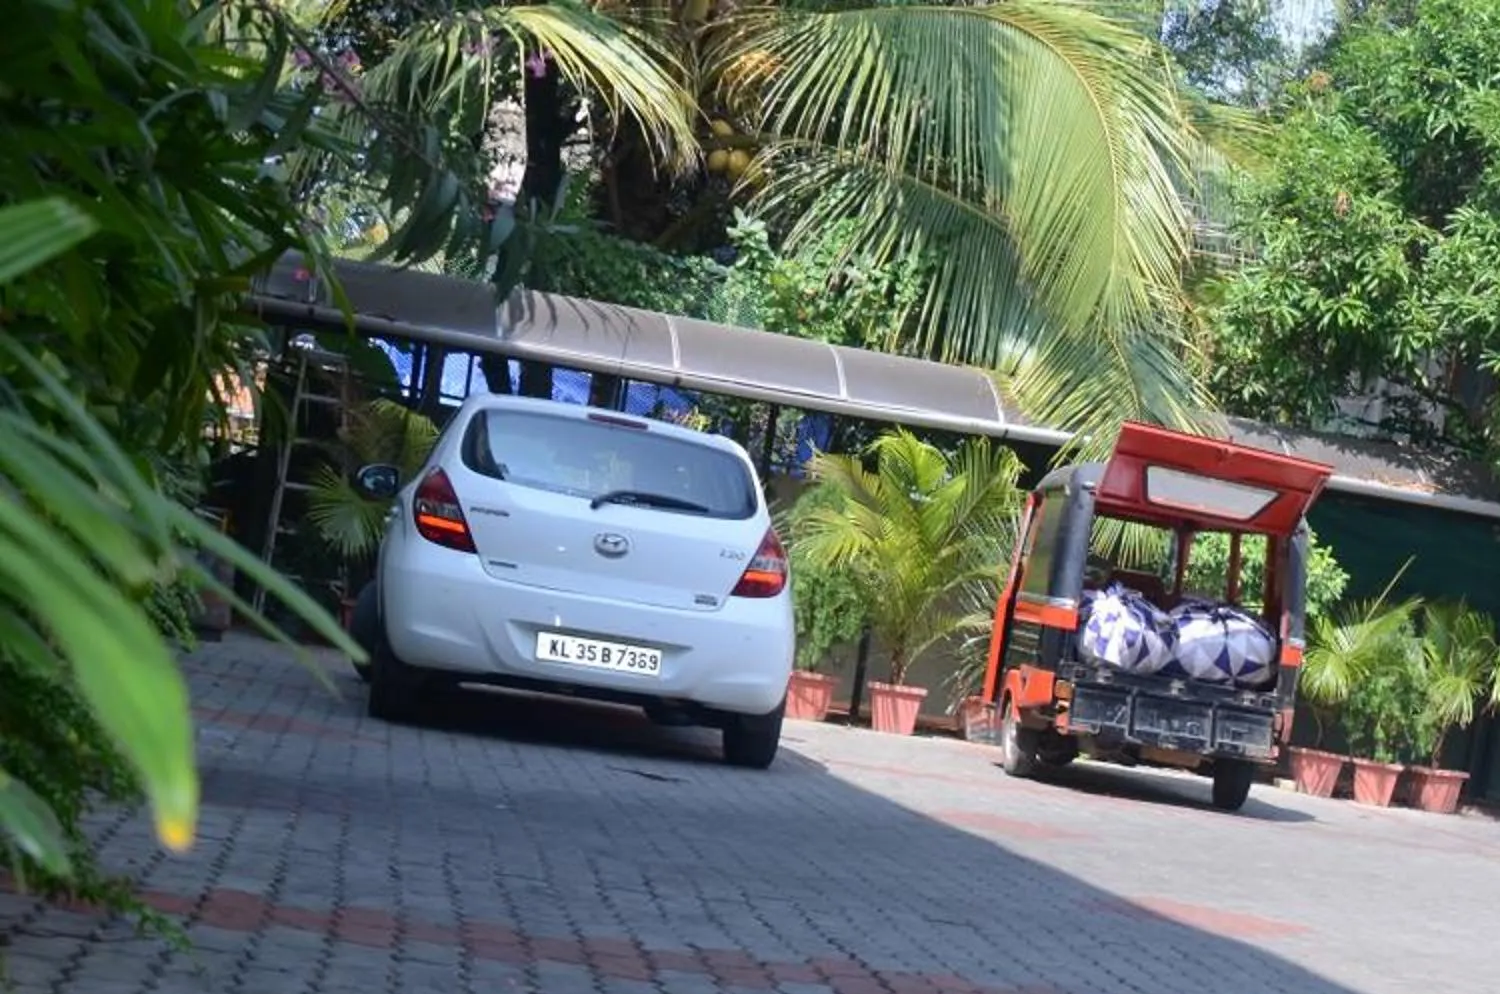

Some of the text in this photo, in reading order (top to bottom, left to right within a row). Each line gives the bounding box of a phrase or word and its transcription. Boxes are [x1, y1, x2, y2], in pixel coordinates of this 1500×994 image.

[549, 639, 570, 658] KL
[576, 643, 597, 661] 35
[601, 647, 611, 663] B
